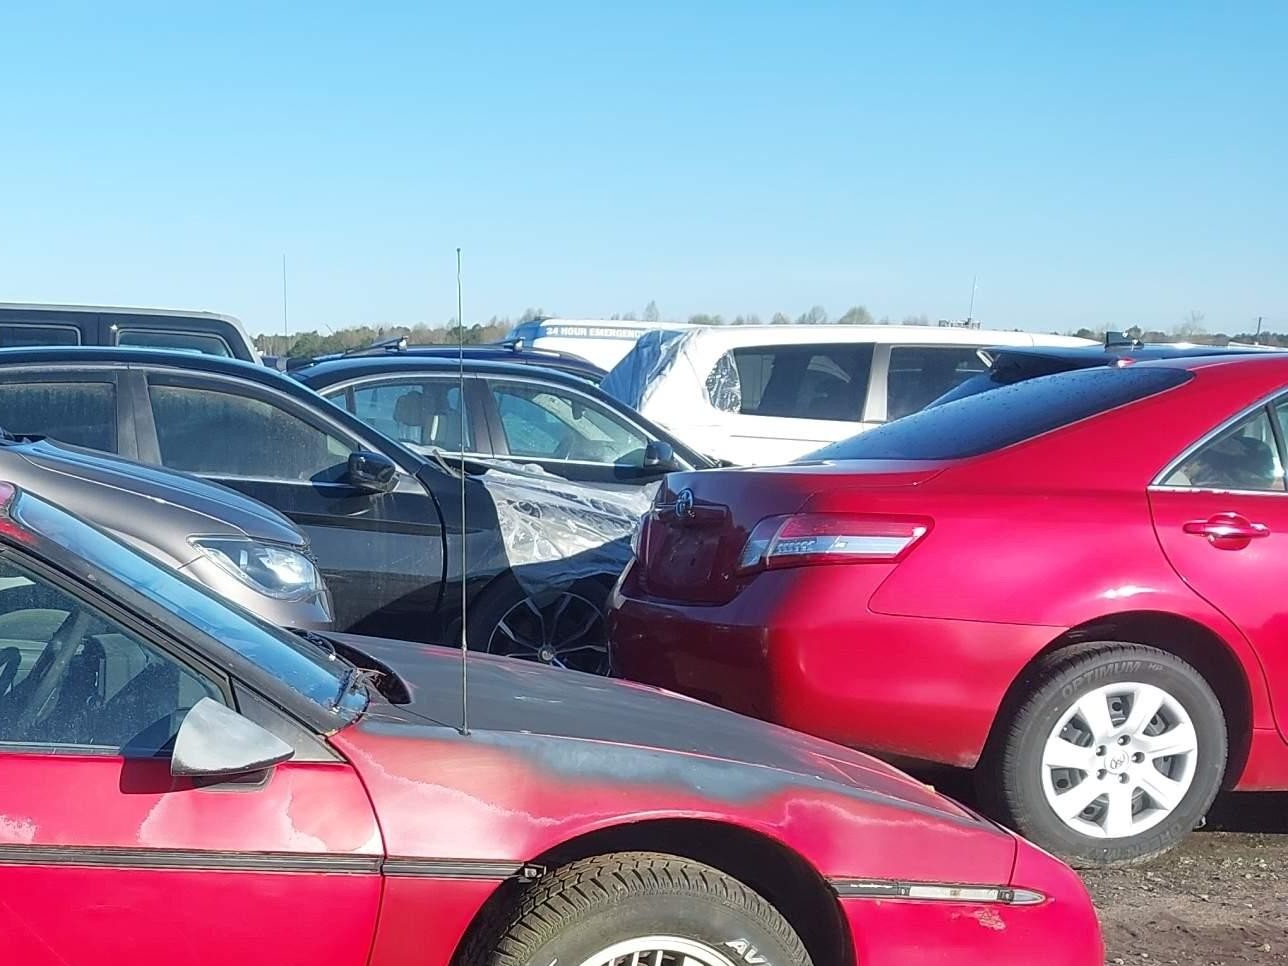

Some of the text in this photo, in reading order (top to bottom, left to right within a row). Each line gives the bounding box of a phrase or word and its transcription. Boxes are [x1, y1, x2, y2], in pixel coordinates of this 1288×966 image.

[545, 327, 644, 338] 24 HOUR EMERGENC
[1062, 661, 1142, 697] OPTIMUM
